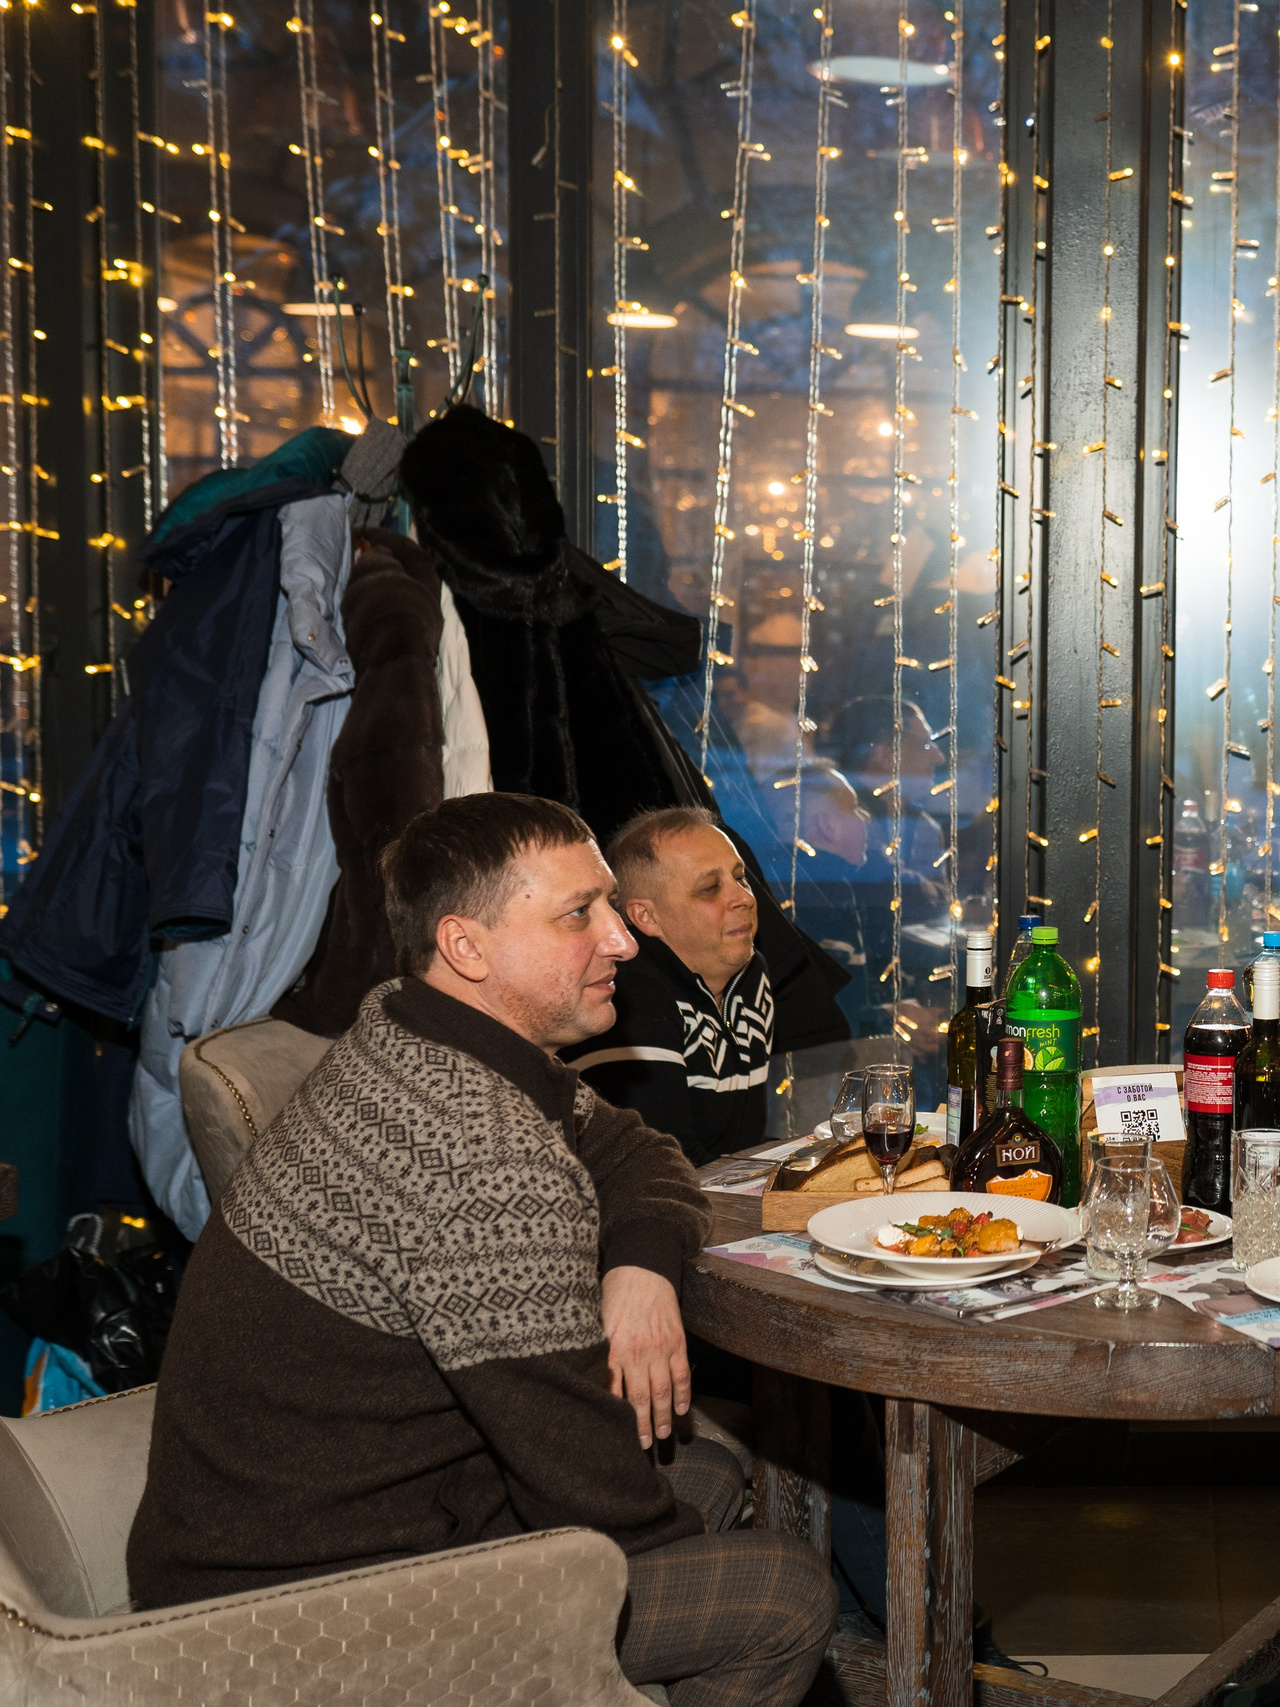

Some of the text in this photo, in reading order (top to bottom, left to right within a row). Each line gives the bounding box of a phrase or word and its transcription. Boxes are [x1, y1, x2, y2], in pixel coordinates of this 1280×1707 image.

[1006, 1024, 1060, 1042] monfresh
[1039, 1038, 1057, 1047] MINT
[1117, 1083, 1153, 1094] С ЗАБОТОЙ
[1133, 1093, 1146, 1102] ВАС
[1002, 1145, 1036, 1162] НОЙ
